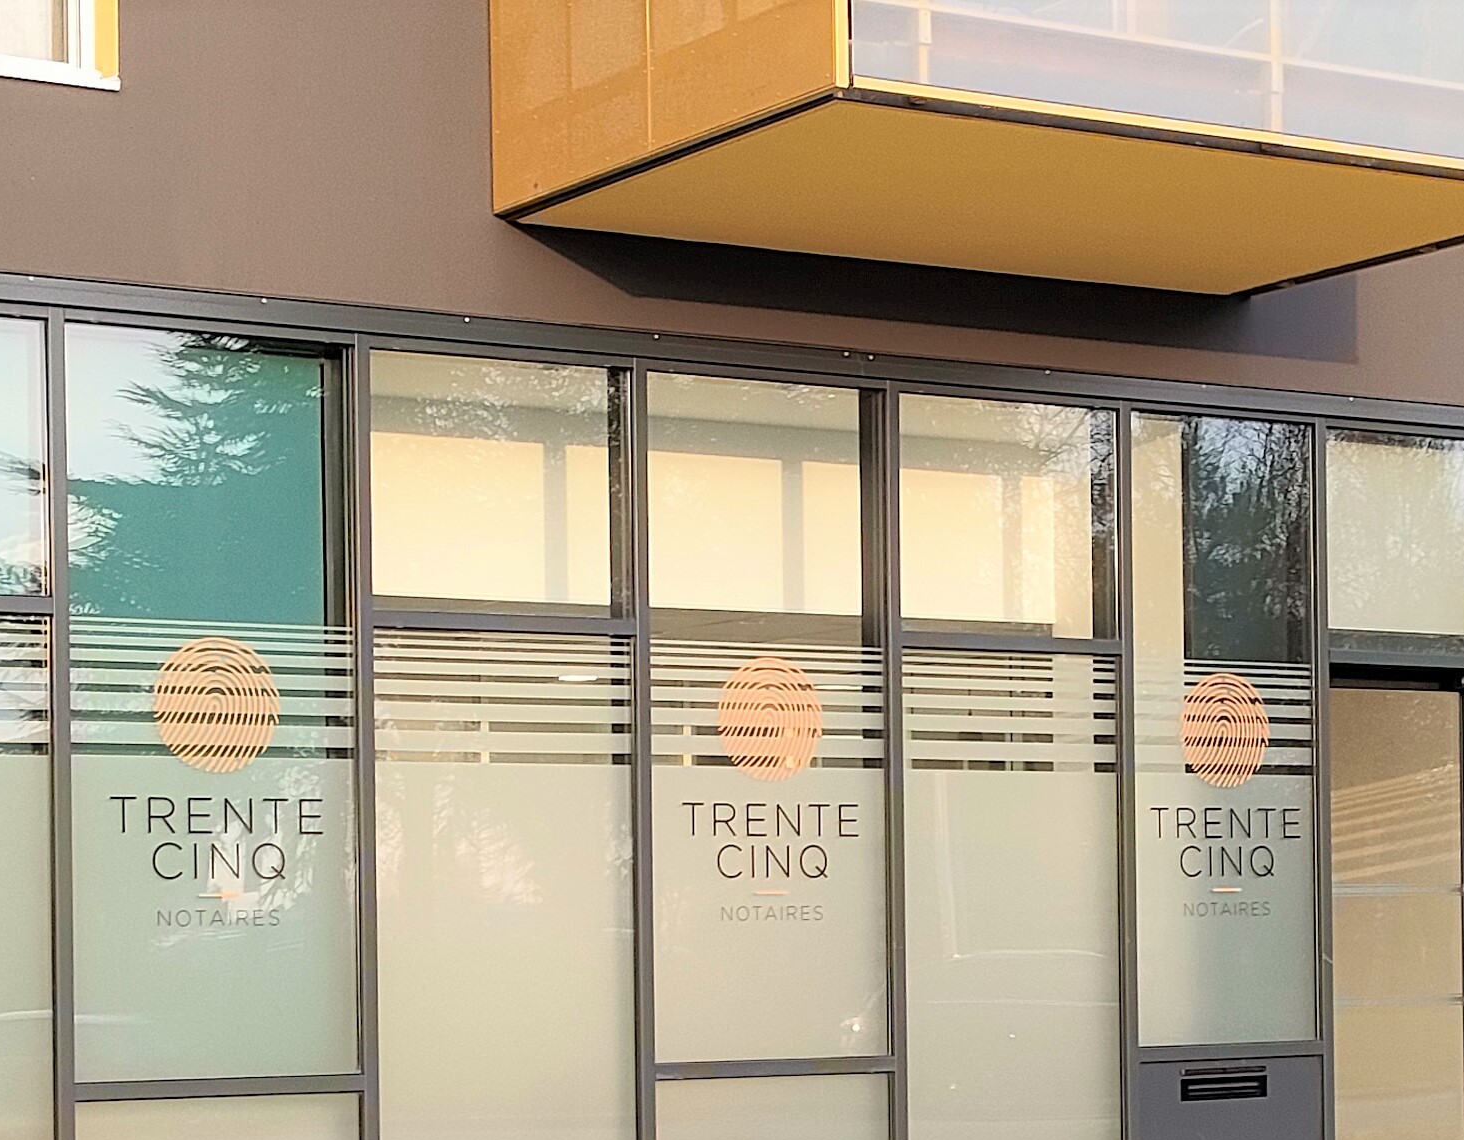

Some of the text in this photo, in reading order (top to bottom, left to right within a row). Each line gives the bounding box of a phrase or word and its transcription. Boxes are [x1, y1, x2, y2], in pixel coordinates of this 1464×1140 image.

[109, 796, 324, 835] TRENTE
[682, 802, 859, 837] TRENTE
[1150, 807, 1302, 839] TRENTE
[152, 842, 286, 880] CINQ
[717, 844, 828, 879] CINQ
[1180, 845, 1274, 878] CINQ
[157, 909, 281, 927] NOTAIRES
[721, 905, 824, 922] NOTAIRES
[1183, 902, 1271, 917] NOTAIRES
